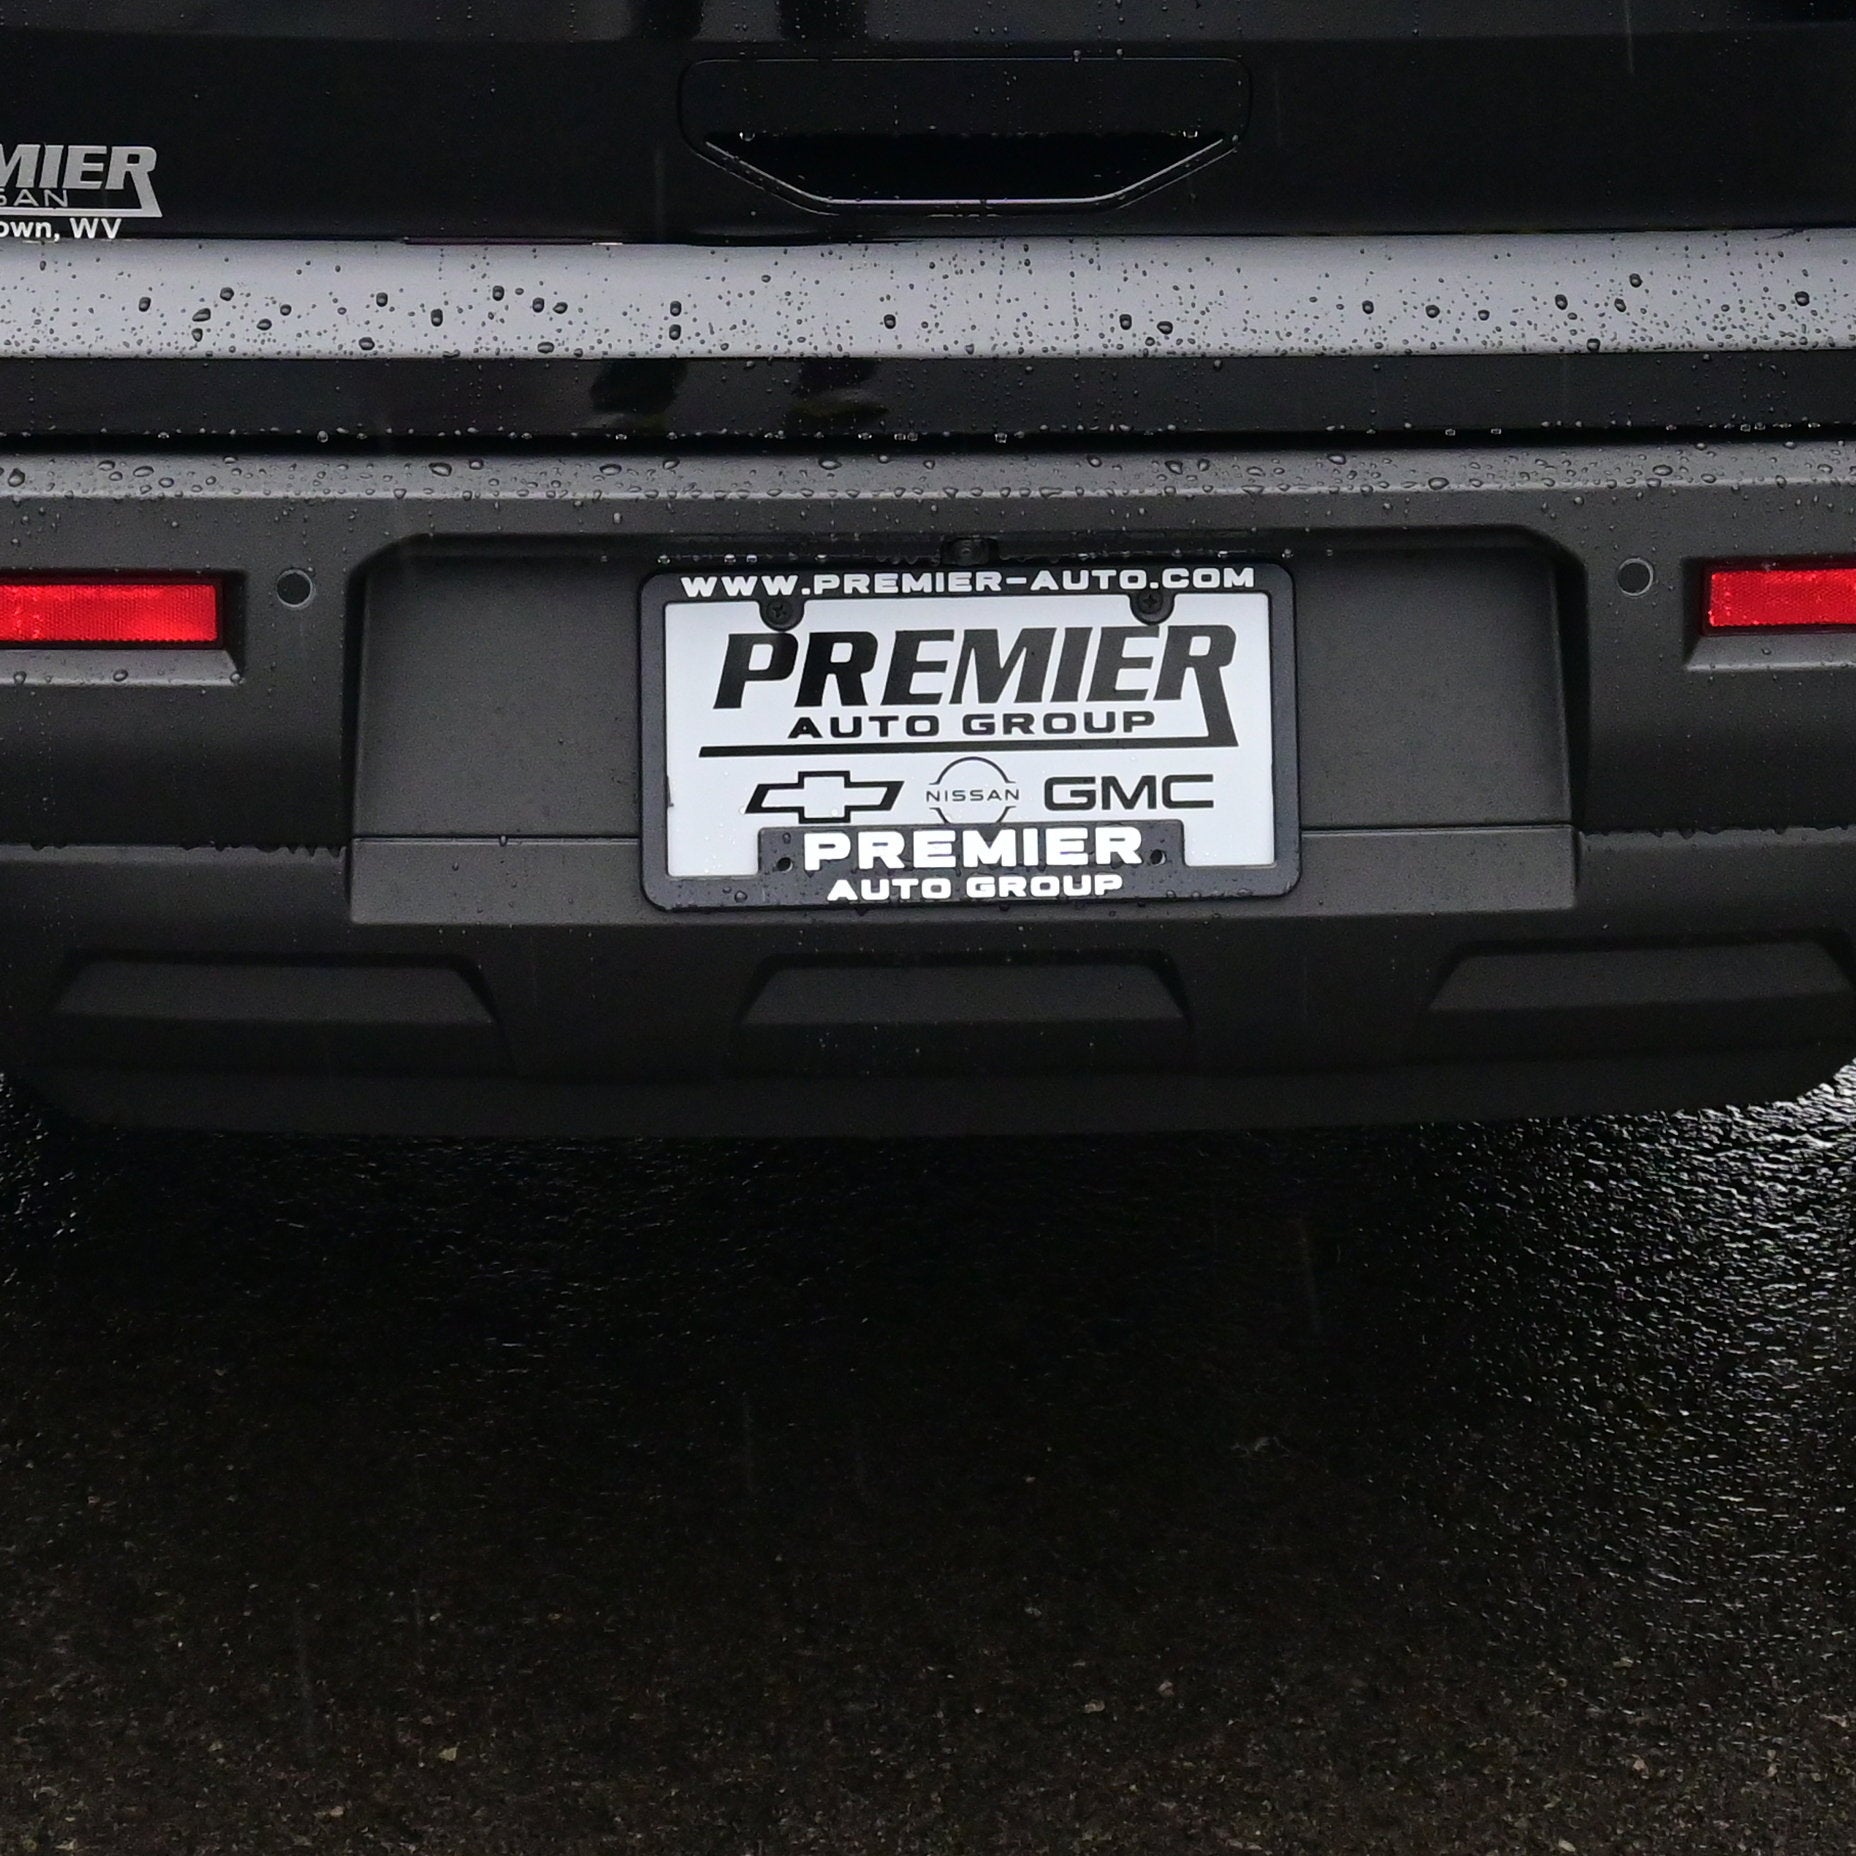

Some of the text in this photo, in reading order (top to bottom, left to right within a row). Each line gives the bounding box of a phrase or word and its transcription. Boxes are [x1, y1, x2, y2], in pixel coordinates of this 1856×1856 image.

[69, 218, 122, 240] WV
[680, 567, 1256, 598] WWW.PREMIER-AUTO.COM
[713, 624, 1239, 748] PREMIER
[787, 710, 1156, 739] AUTO GROUP
[926, 774, 1214, 811] NISSAN GMC
[803, 826, 1145, 871] PREMIER
[827, 874, 1123, 901] AUTO GROUP
